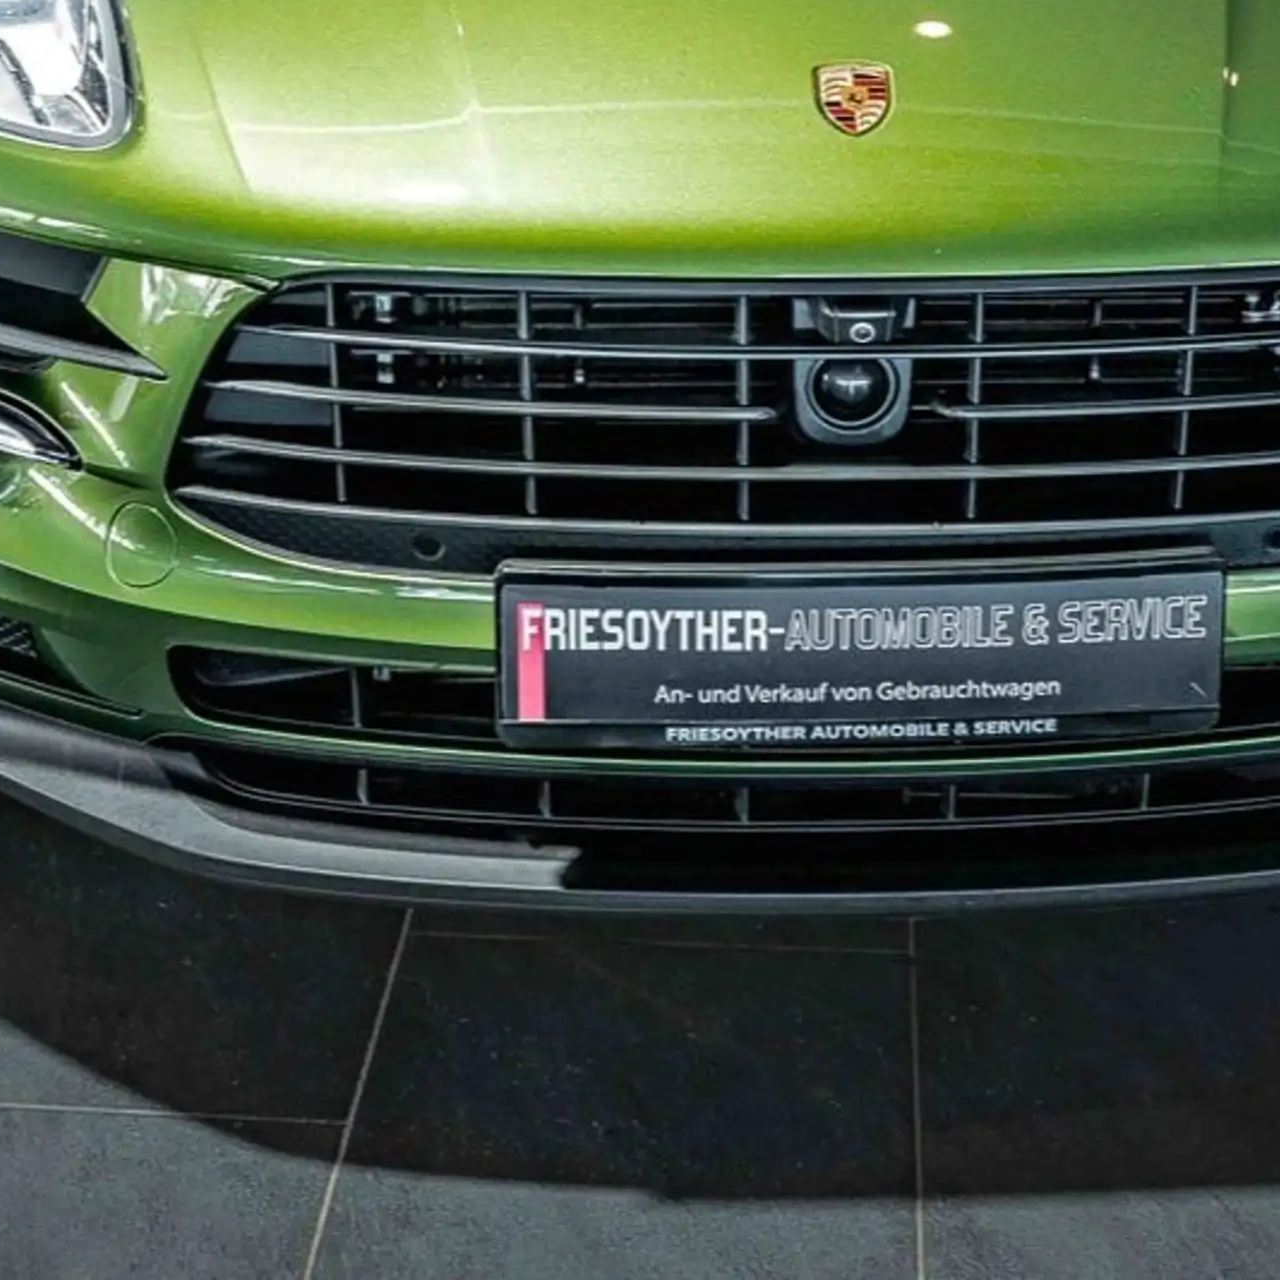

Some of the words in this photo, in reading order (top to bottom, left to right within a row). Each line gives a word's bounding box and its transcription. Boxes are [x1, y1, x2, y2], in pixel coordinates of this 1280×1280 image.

[520, 604, 1014, 652] FRIESOYTHER-AUTOMOBILE
[1022, 603, 1050, 646] &
[1058, 595, 1209, 644] SERVICE
[654, 686, 693, 704] An-
[699, 684, 741, 704] und
[746, 682, 829, 704] Verkauf
[831, 684, 872, 702] von
[877, 679, 1062, 702] Gebrauchtwagen
[665, 725, 808, 742] FRIESOYTHER
[810, 721, 949, 740] AUTOMOBILE
[954, 722, 970, 737] &
[973, 719, 1058, 736] SERVICE
